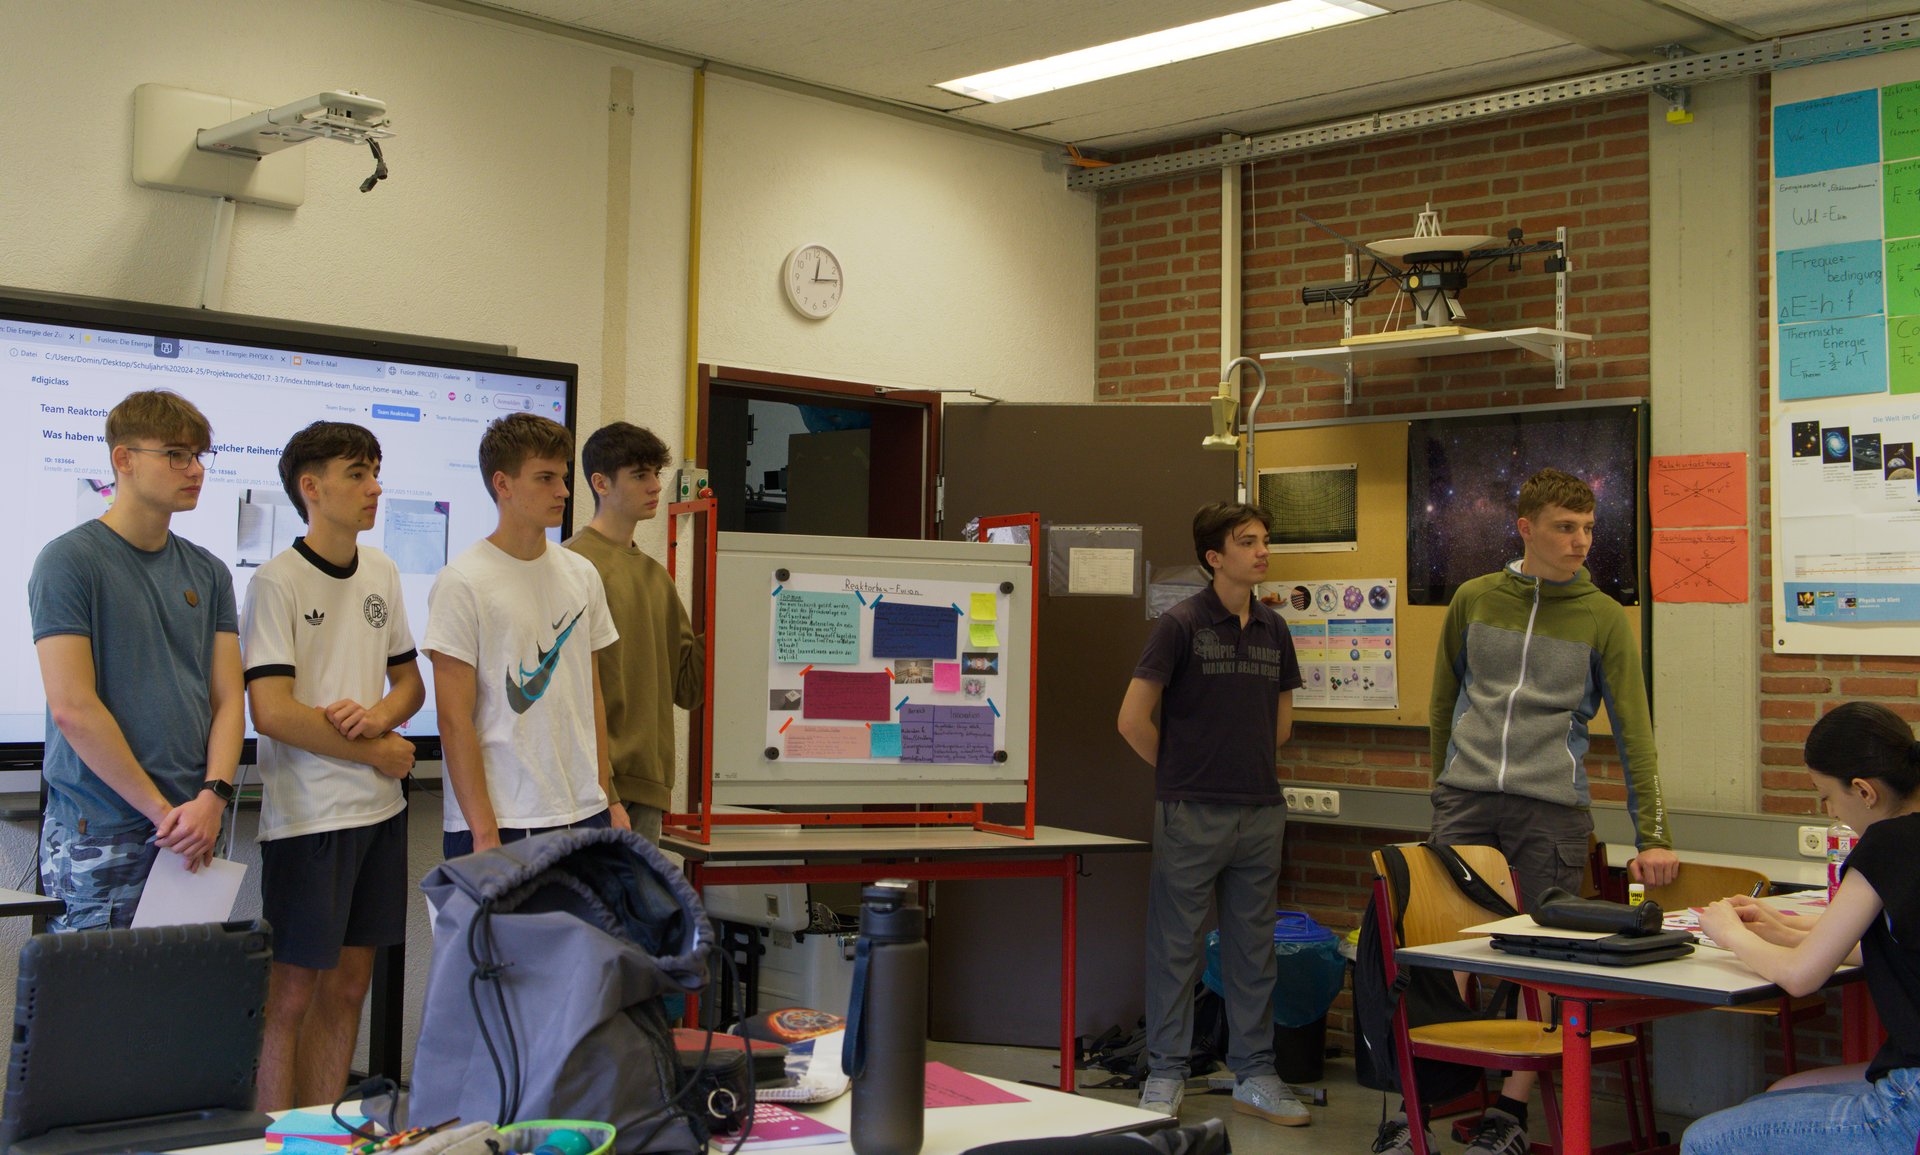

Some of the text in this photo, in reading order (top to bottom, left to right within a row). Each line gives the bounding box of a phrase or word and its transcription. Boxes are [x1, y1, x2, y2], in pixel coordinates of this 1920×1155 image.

[805, 252, 811, 260] 11
[814, 249, 820, 259] 12
[797, 260, 804, 269] 10
[832, 267, 836, 275] 2
[1828, 270, 1882, 285] bedingung
[796, 286, 800, 294] 8
[813, 302, 817, 310] 6
[823, 300, 827, 308] 5
[18, 328, 41, 337] Energie
[1783, 326, 1844, 339] Thermische
[97, 336, 118, 344] Fusion:
[131, 339, 153, 349] Energie
[1824, 338, 1866, 354] Energie
[31, 375, 69, 386] #digiclass
[40, 403, 65, 414] Team
[43, 430, 62, 439] Was
[65, 431, 94, 441] haben
[212, 444, 244, 453] welcher
[1656, 797, 1661, 806] in
